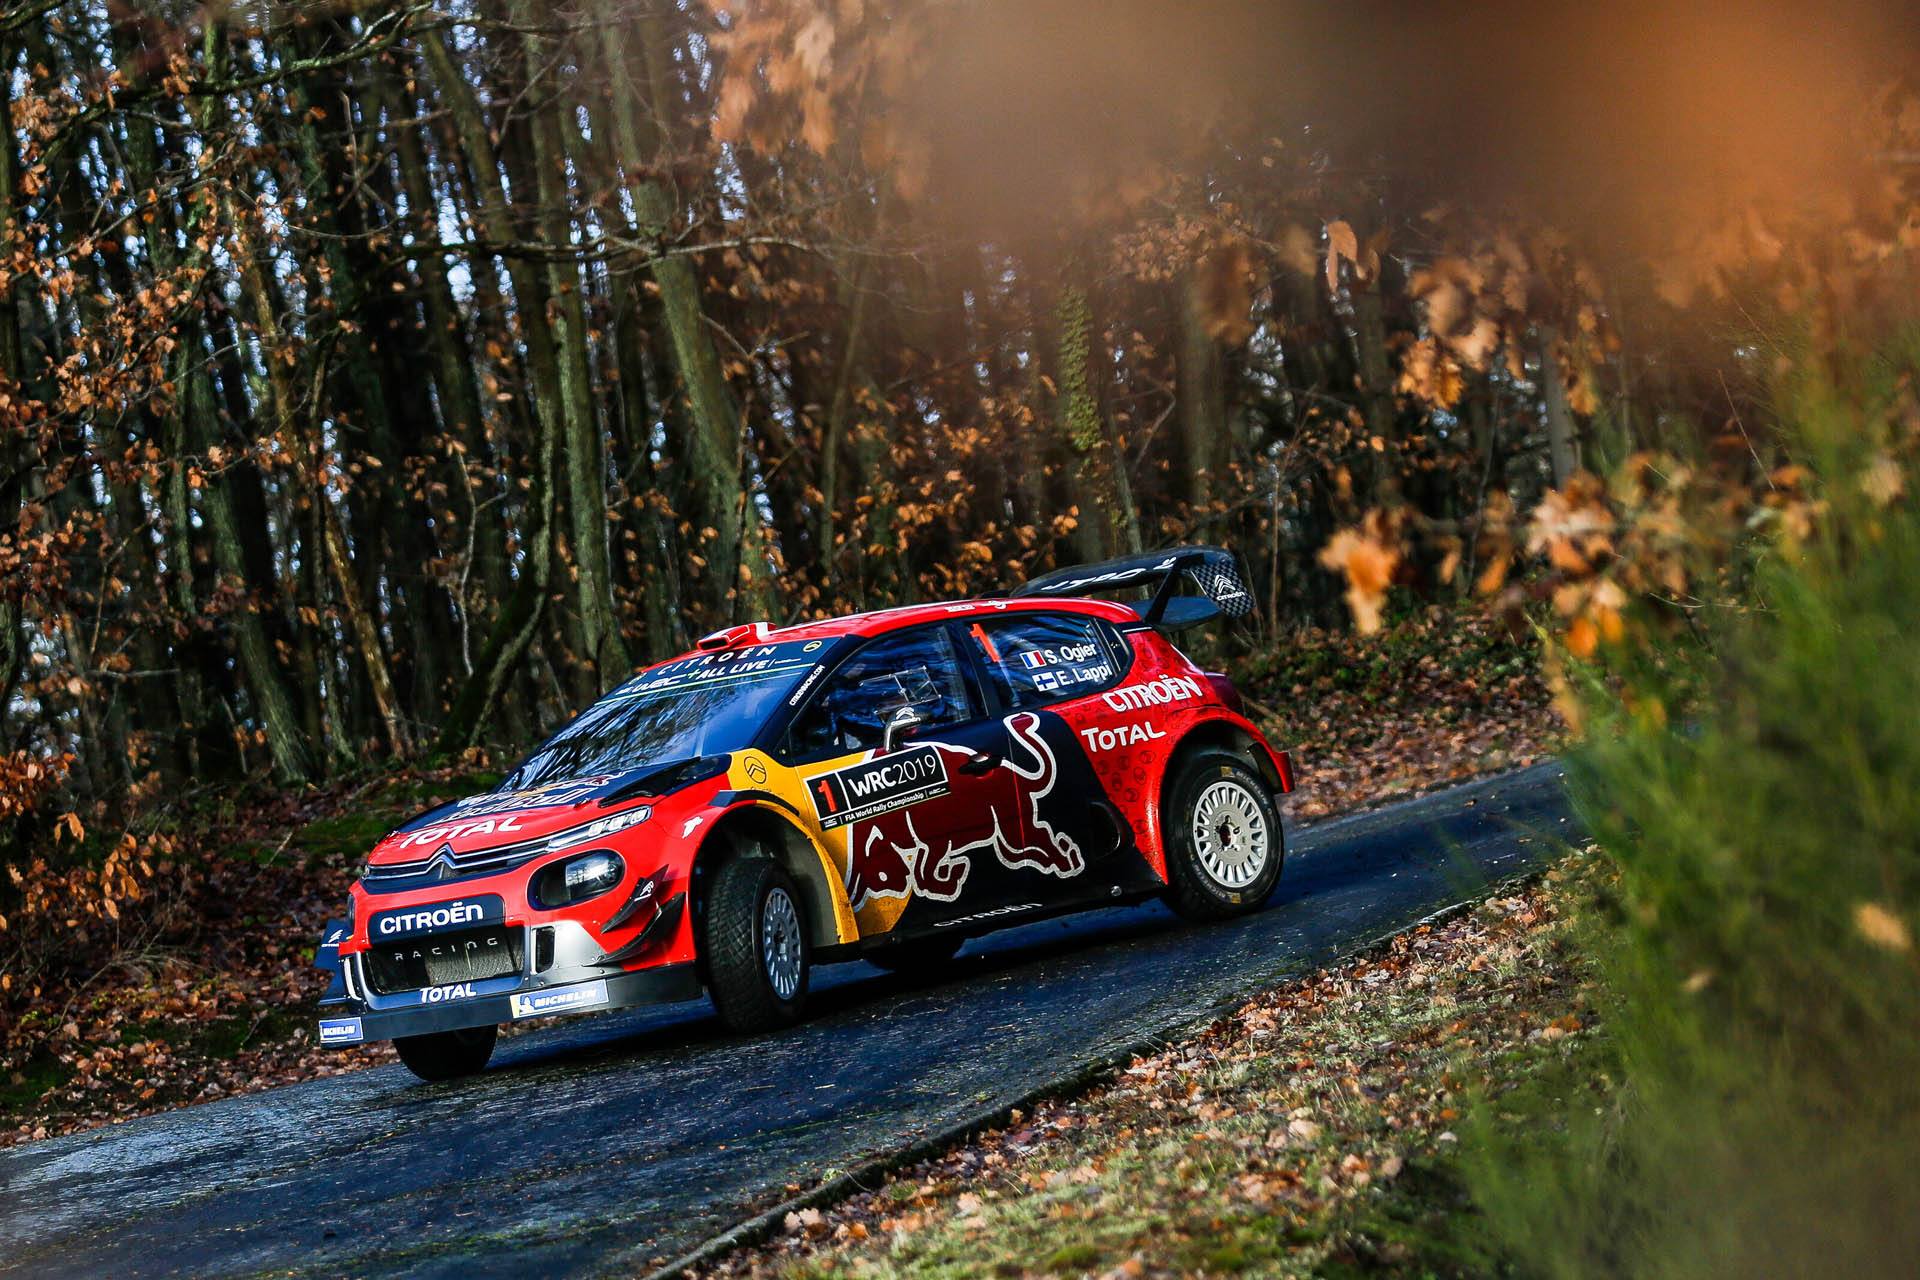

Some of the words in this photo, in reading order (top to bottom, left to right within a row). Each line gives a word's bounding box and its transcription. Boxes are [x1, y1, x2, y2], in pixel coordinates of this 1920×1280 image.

[969, 623, 1000, 663] 1
[1044, 648, 1062, 665] S.
[1061, 643, 1097, 663] Ogier
[696, 666, 727, 681] ALL
[730, 659, 770, 674] LIVE
[1056, 670, 1074, 686] E.
[1075, 661, 1113, 684] Lappi
[1102, 674, 1203, 712] CITROËN
[1081, 721, 1167, 753] TOTAL
[817, 779, 838, 813] 1
[845, 812, 856, 822] FIA
[856, 807, 873, 818] World
[873, 802, 887, 814] Rally
[887, 792, 925, 809] Championship
[400, 816, 524, 849] TOTAL
[380, 901, 484, 935] CITROËN
[394, 936, 499, 962] RACING
[420, 982, 477, 1003] TOTAL
[534, 988, 597, 1008] MICHELIN
